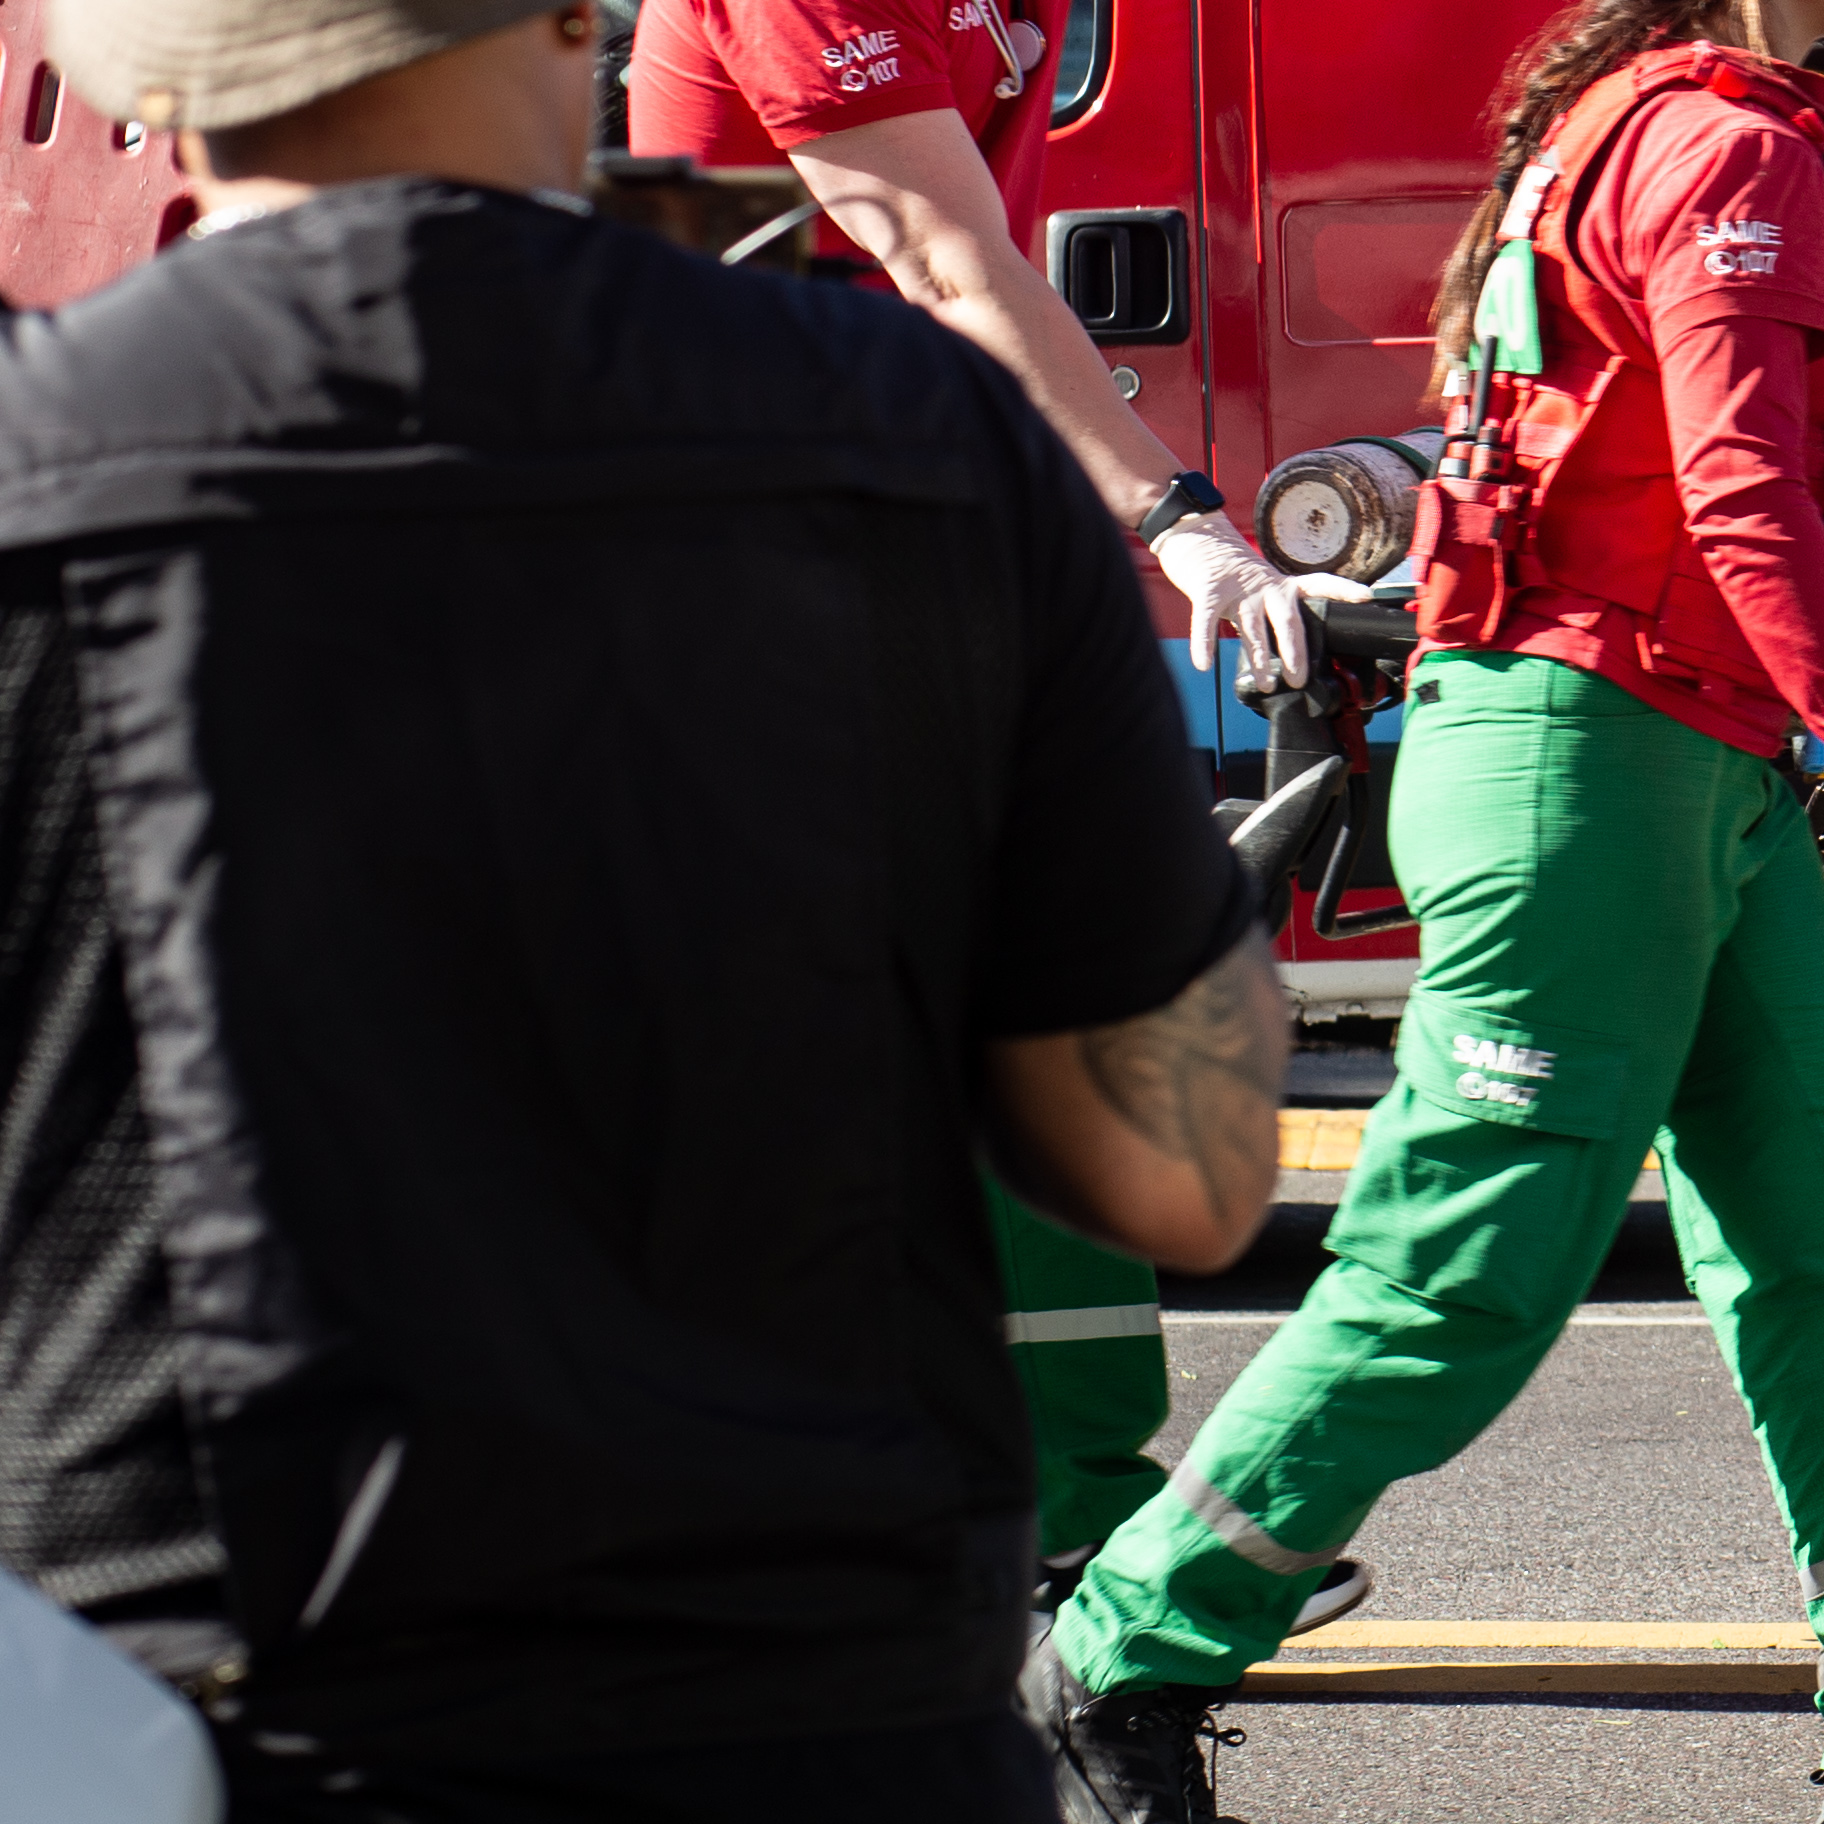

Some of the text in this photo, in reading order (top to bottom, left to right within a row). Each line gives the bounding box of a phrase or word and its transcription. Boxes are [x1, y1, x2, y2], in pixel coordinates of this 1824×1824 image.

[821, 30, 900, 68] SAME
[866, 57, 901, 86] 107
[1696, 220, 1784, 247] SAME
[1452, 1034, 1560, 1080] SAME
